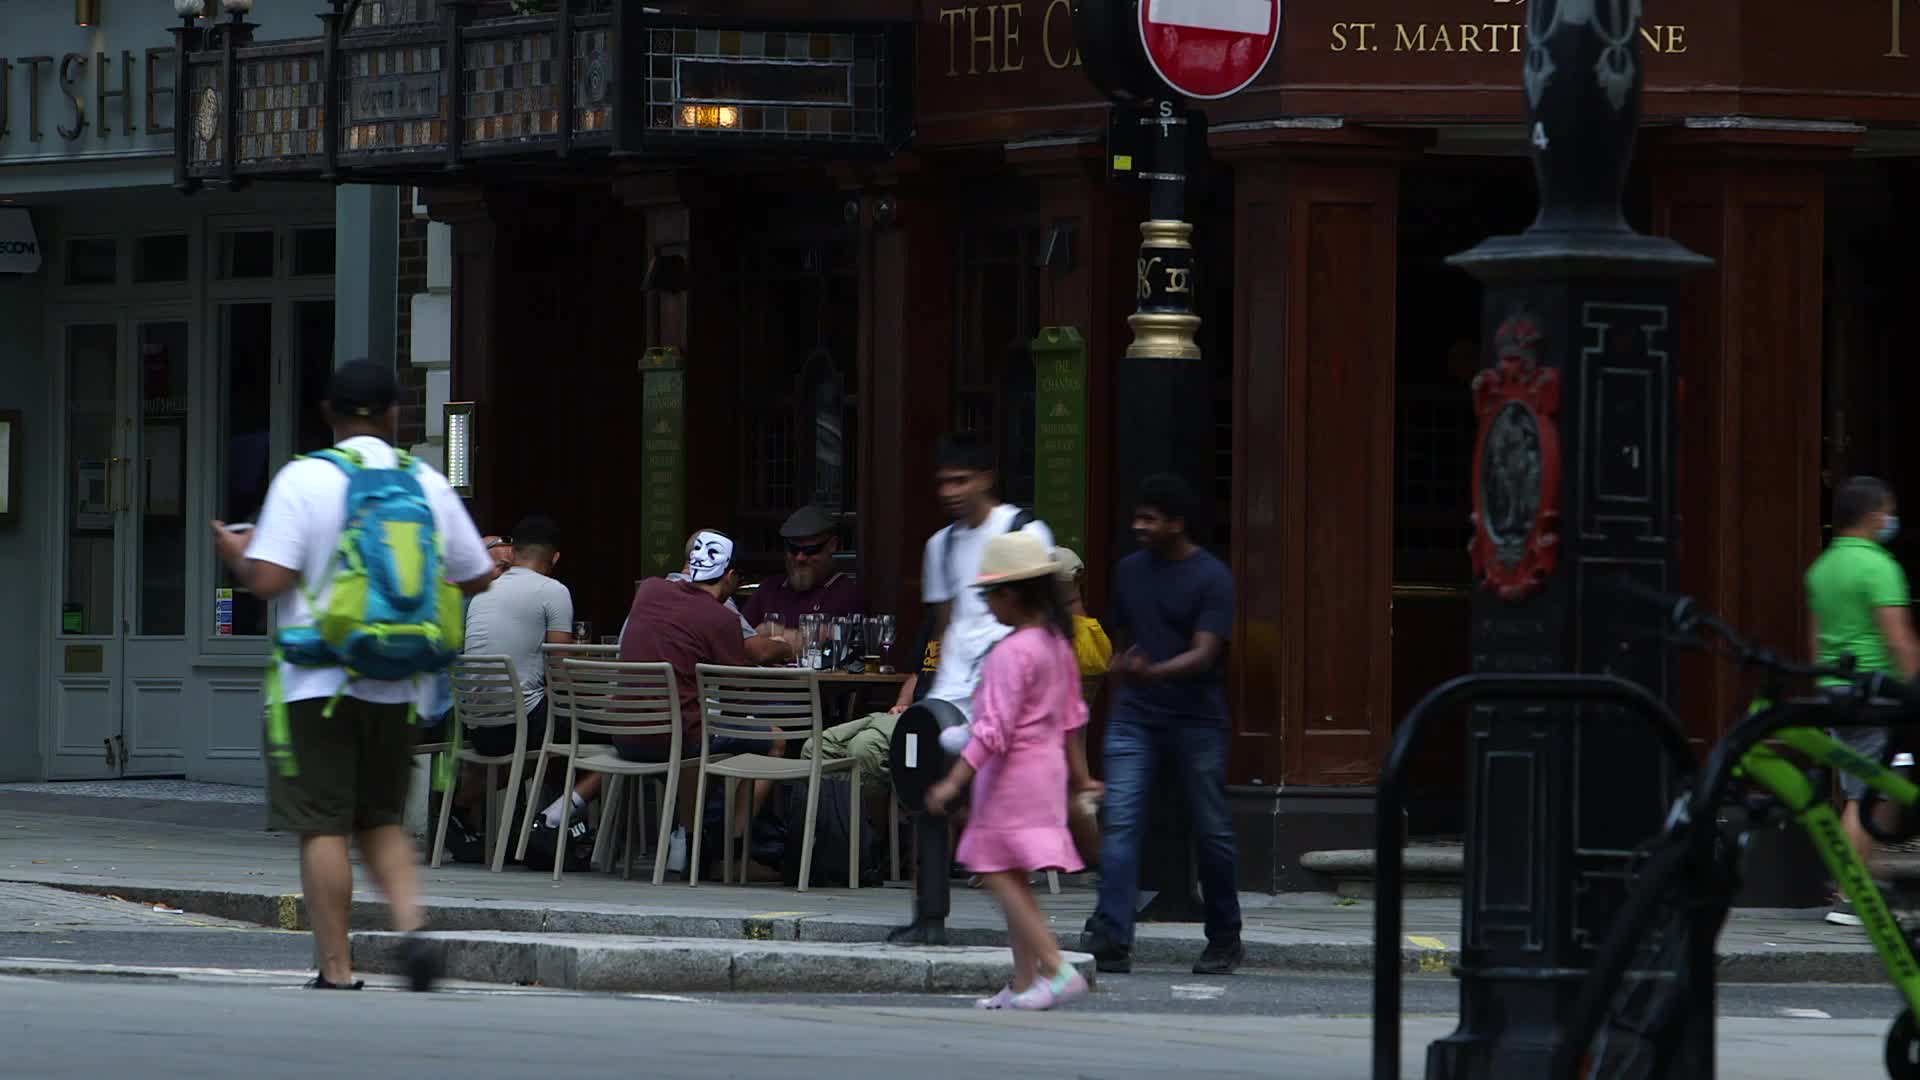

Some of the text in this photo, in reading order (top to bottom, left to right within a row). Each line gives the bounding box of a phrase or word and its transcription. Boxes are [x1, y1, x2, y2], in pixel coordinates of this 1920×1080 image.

[937, 0, 1083, 78] THE C
[1329, 22, 1688, 54] ST. MARTI NE
[1531, 121, 1549, 150] 4
